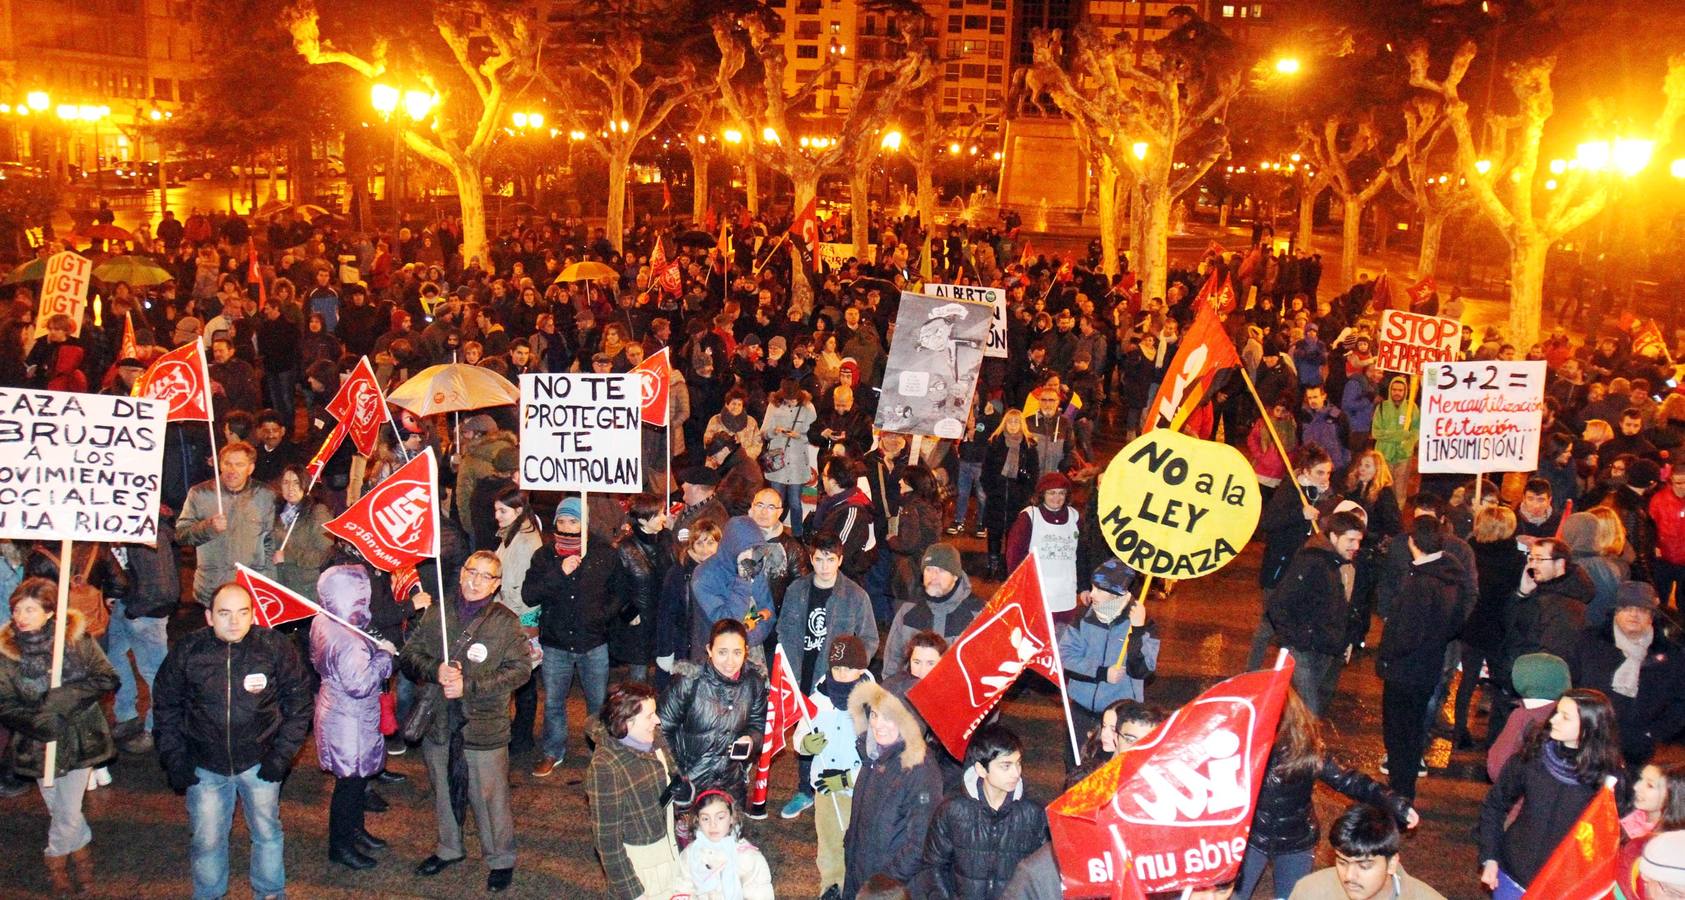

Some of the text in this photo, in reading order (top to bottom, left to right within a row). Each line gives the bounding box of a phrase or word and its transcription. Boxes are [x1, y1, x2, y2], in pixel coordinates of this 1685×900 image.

[50, 255, 87, 275] UGT
[46, 275, 83, 296] UGT
[42, 295, 80, 317] UGT
[1386, 311, 1459, 347] STOP
[534, 375, 571, 400] NO
[581, 377, 625, 401] TE
[112, 398, 154, 419] DE
[525, 404, 639, 430] PROTEGEN
[0, 419, 156, 451] BRUJAS
[552, 431, 592, 453] TE
[1426, 434, 1526, 462] ¡INSUMISIÓN!
[23, 446, 114, 466] A LOS
[524, 455, 638, 484] CONTROLAN
[1128, 441, 1246, 507] NO a la
[22, 511, 53, 530] LA
[375, 486, 430, 539] UGT
[1138, 492, 1209, 533] LEY
[343, 521, 402, 567] www.ugt.es
[1101, 505, 1239, 575] MORDAZA
